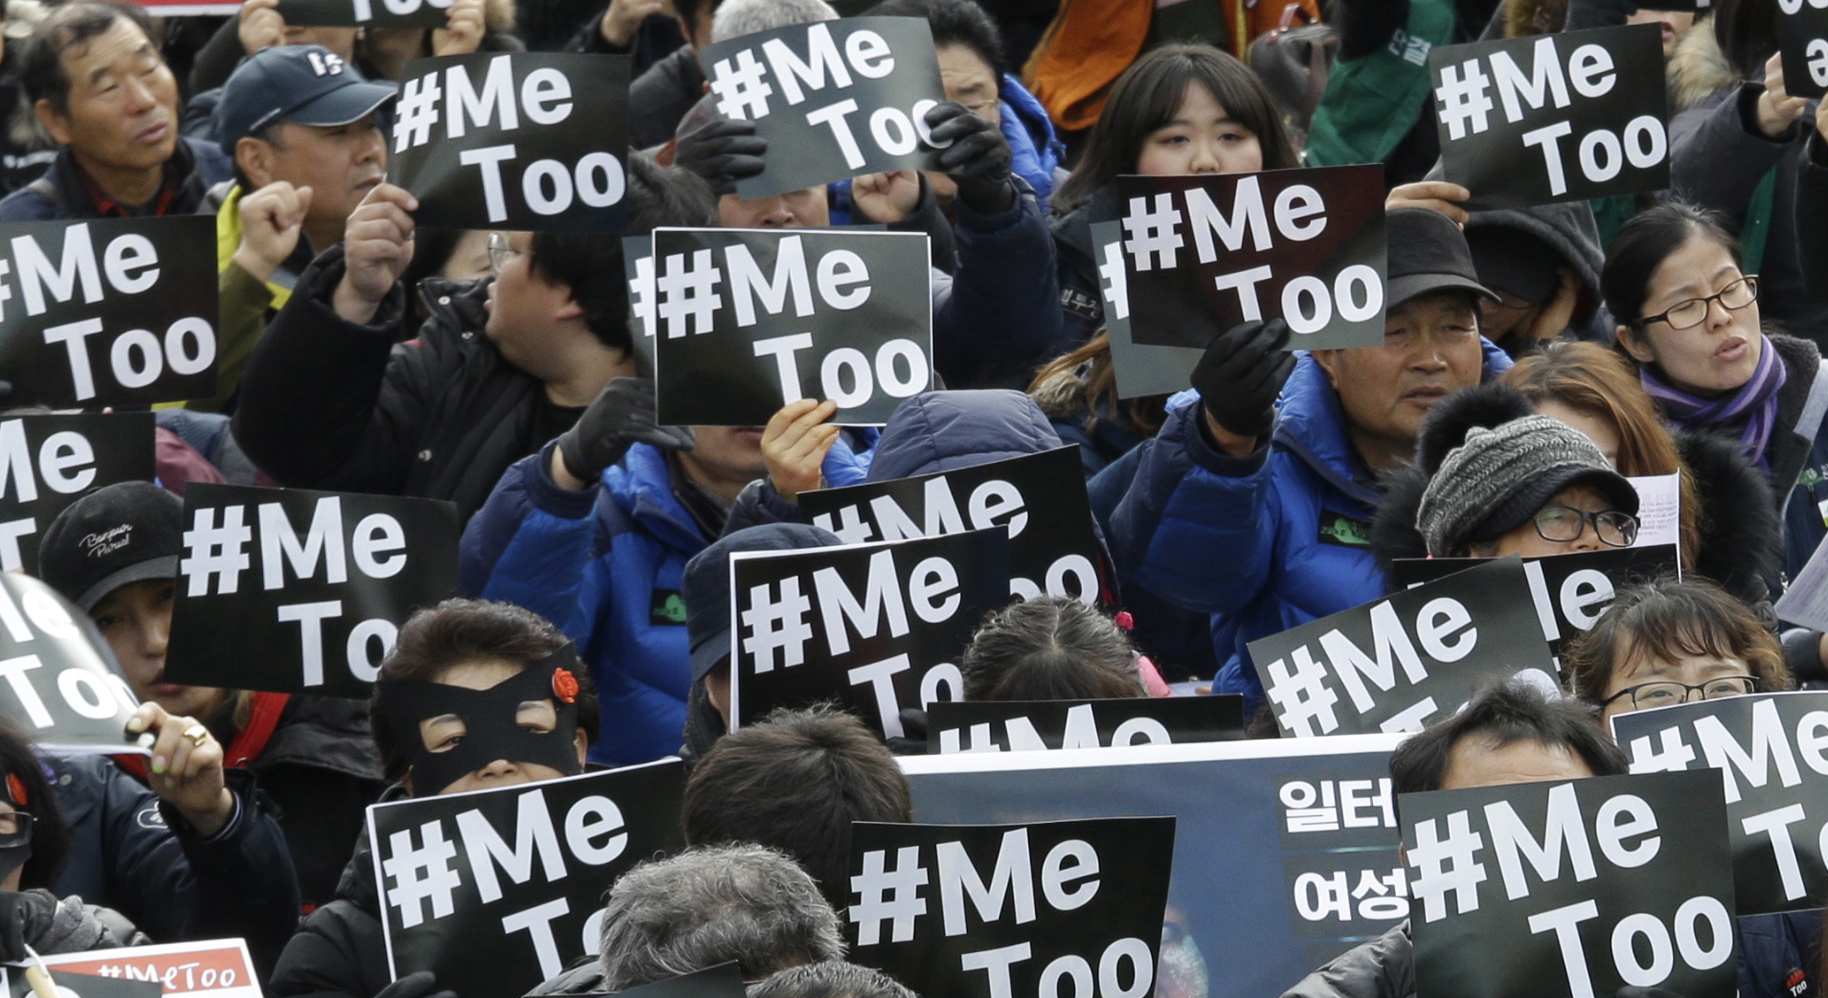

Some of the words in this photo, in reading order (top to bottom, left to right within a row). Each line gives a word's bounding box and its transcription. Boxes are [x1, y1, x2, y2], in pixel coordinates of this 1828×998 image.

[393, 55, 572, 153] #Me
[711, 23, 895, 120] #Me
[1435, 37, 1617, 140] #Me
[806, 99, 953, 170] Too
[1522, 115, 1667, 196] Too
[460, 145, 625, 222] Too
[1122, 176, 1327, 272] #Me
[0, 222, 160, 320] Me
[657, 236, 871, 338] #Me
[1215, 264, 1383, 334] Too
[43, 318, 217, 400] Too
[753, 332, 930, 408] Too
[180, 495, 407, 597] #Me
[278, 600, 398, 686] To
[741, 549, 960, 674] #Me
[848, 653, 963, 738] To
[1266, 597, 1478, 737] #Me
[383, 788, 628, 928] #Me
[849, 827, 1100, 945] #Me
[1294, 866, 1410, 923] 여성
[1407, 783, 1661, 922] #Me
[1789, 980, 1808, 998] Too
